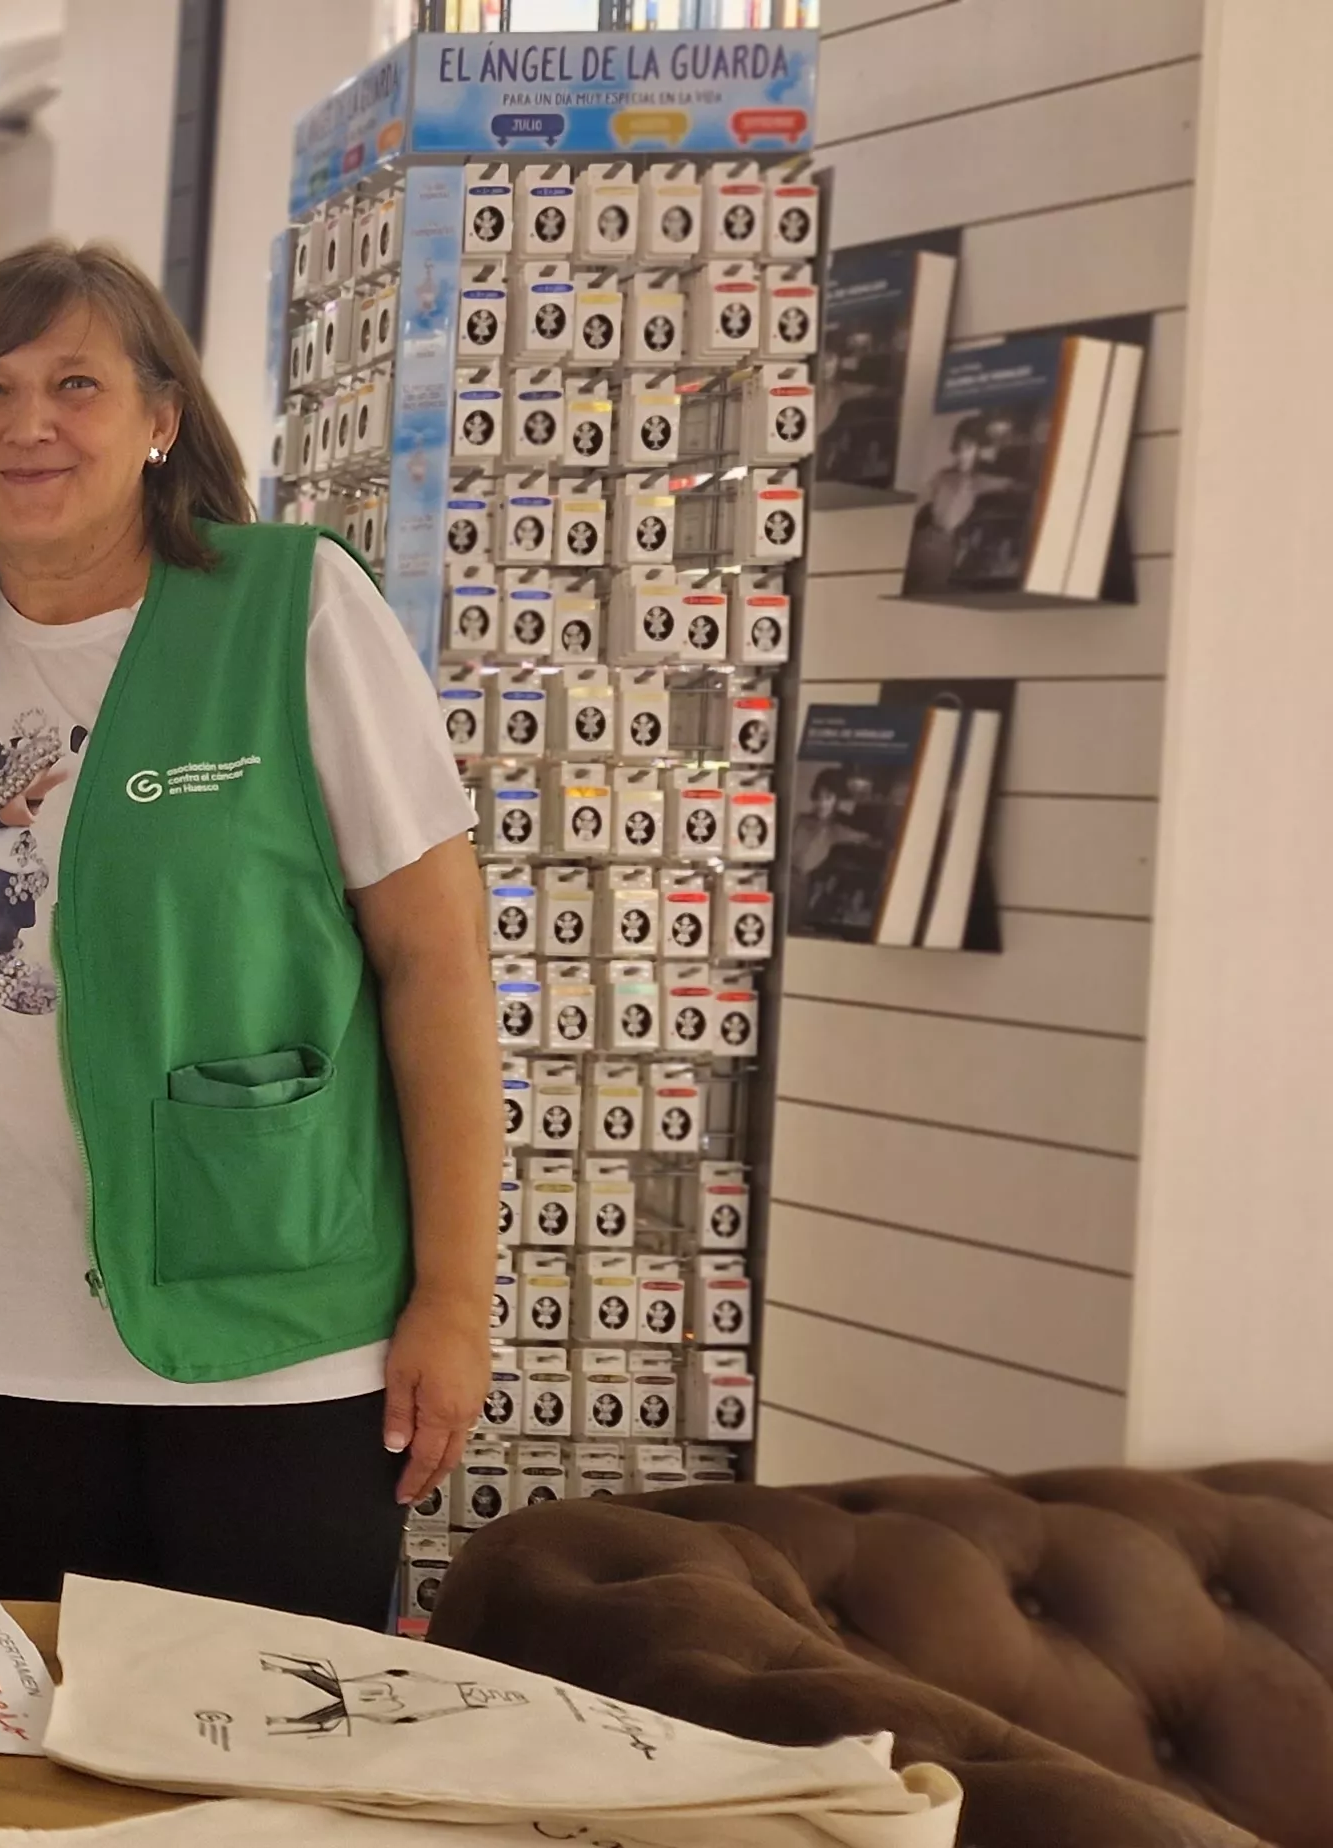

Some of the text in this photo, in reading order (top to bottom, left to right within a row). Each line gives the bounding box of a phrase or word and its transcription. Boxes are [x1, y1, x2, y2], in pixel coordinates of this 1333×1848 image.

[439, 41, 789, 83] EL ÁNGEL DE LA GUARDA
[502, 93, 532, 107] PARA
[535, 92, 552, 106] UN
[555, 89, 573, 106] DÍA
[576, 92, 602, 105] MUY
[605, 91, 655, 106] ESPECIAL
[511, 118, 543, 133] JULIO
[166, 754, 262, 777] asociación española
[167, 769, 244, 786] contra el cáncer
[169, 786, 182, 795] en
